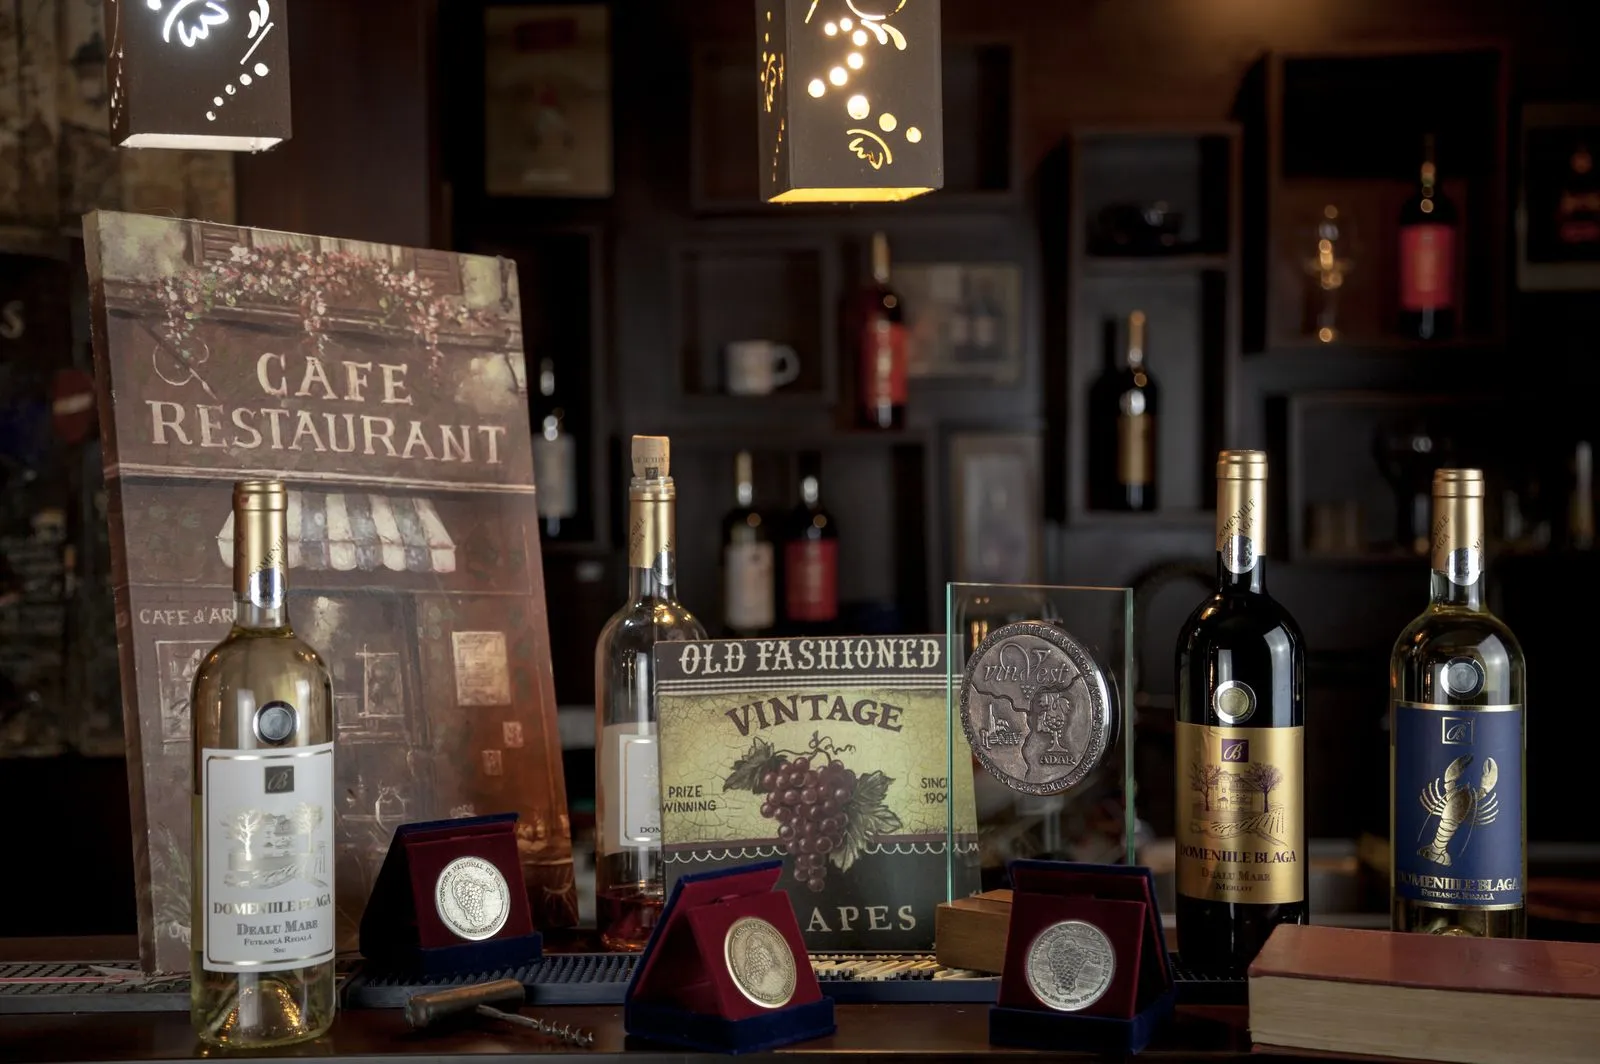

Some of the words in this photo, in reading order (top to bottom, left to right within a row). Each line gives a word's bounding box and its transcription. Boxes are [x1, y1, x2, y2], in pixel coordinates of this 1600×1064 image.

[257, 352, 413, 406] CAFE
[145, 399, 507, 465] RESTAURANT
[139, 607, 189, 626] CAFE
[678, 641, 747, 676] OLD
[755, 637, 942, 673] FASHIONED
[724, 693, 905, 737] VINTAGE
[920, 776, 947, 789] SINC
[668, 784, 703, 799] PRIZE
[924, 792, 947, 804] 190
[662, 800, 717, 813] WINNING
[1254, 850, 1297, 864] BLAGA
[1478, 877, 1520, 892] BLAGA
[213, 900, 296, 916] DOMENIILE
